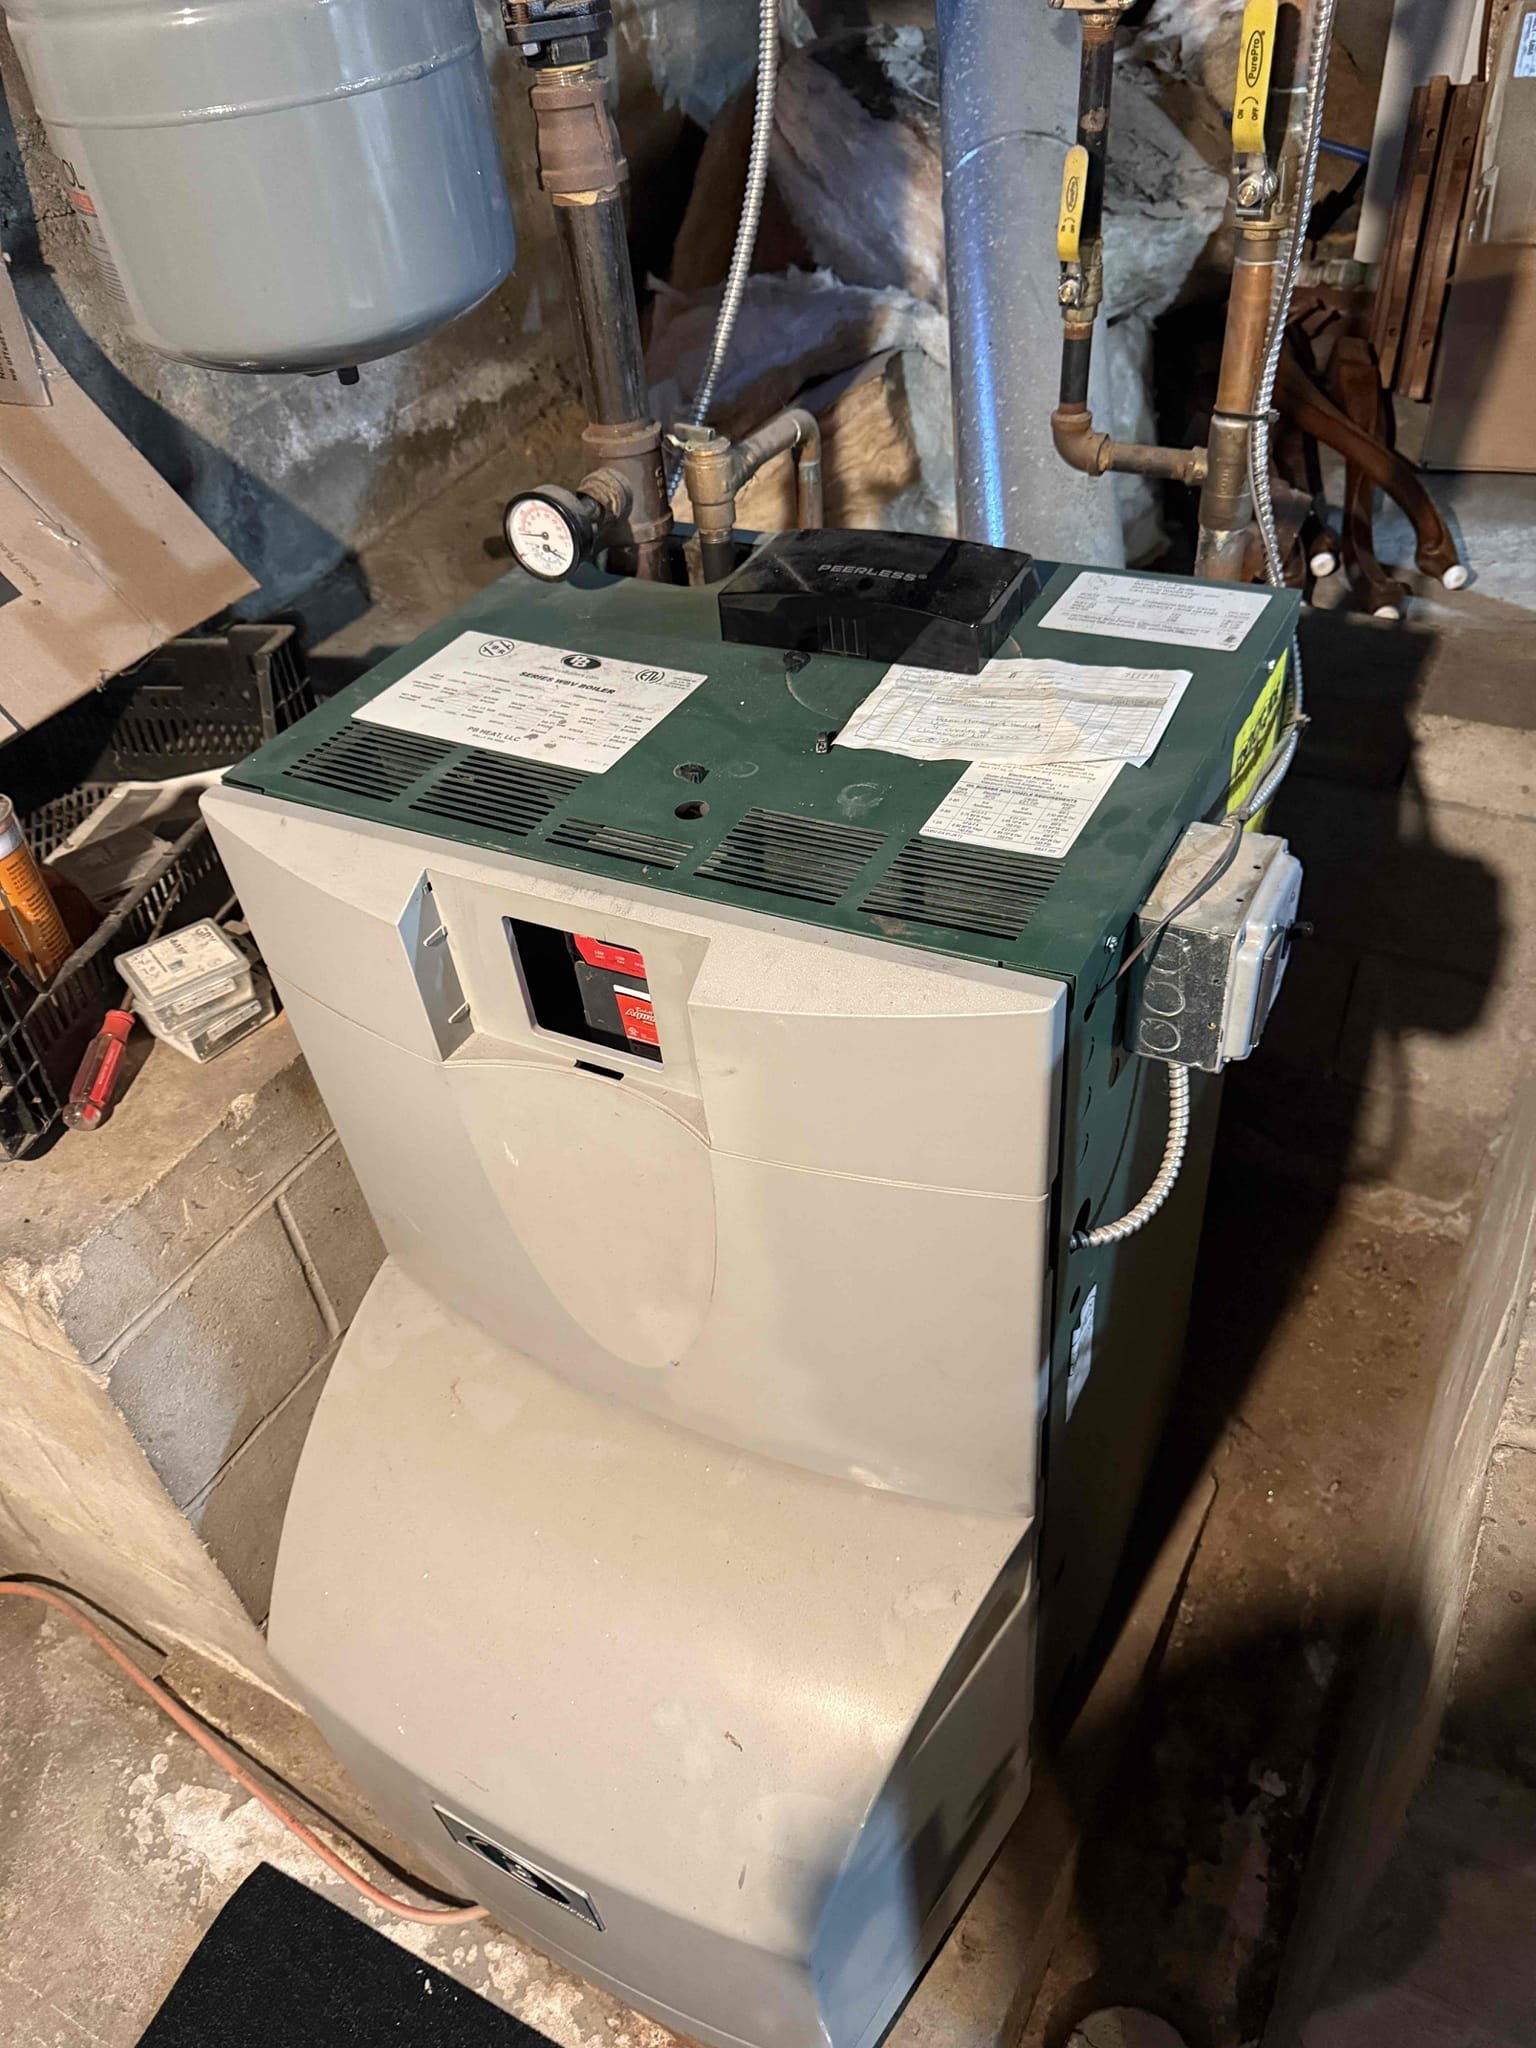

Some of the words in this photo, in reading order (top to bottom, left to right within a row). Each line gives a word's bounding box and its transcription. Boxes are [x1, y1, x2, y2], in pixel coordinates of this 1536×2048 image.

[1248, 38, 1260, 80] PurePro
[1251, 107, 1259, 121] OFF
[817, 564, 917, 582] PEERLESS
[519, 671, 554, 683] SERIES
[554, 678, 578, 687] WBV
[578, 683, 617, 695] BOILER
[503, 733, 521, 742] LLC
